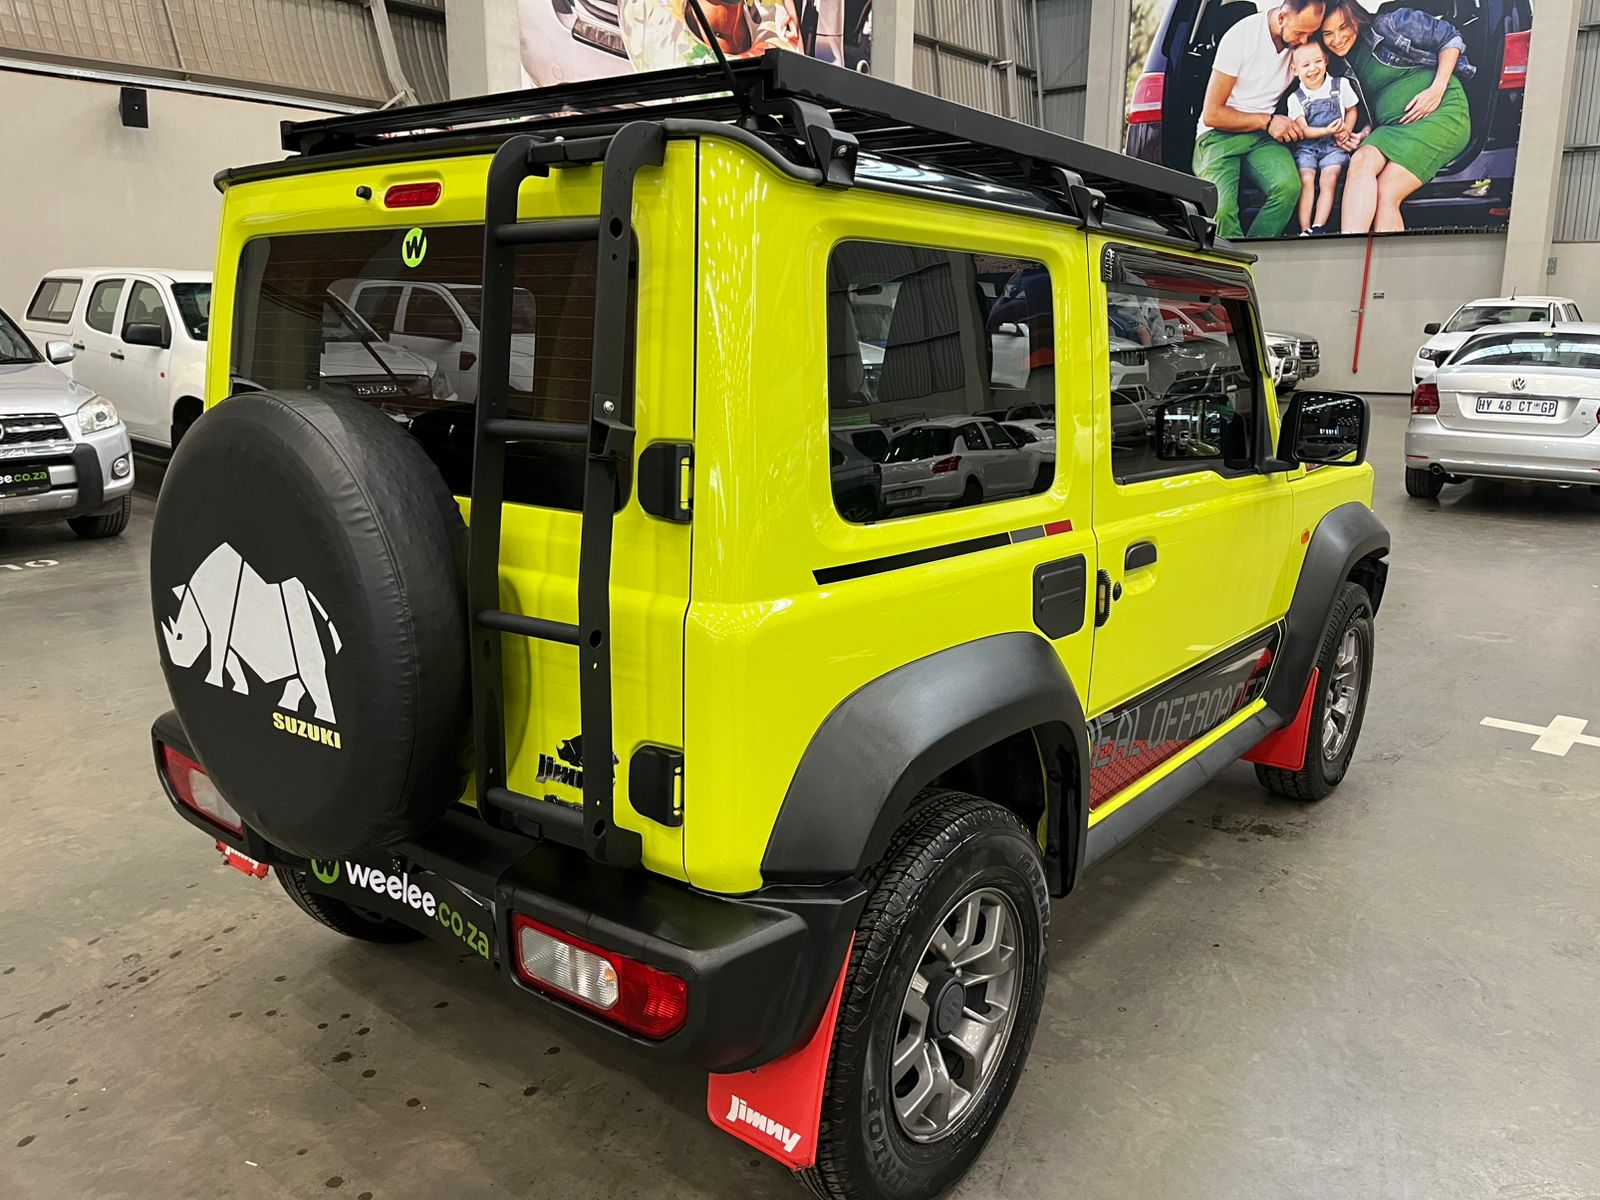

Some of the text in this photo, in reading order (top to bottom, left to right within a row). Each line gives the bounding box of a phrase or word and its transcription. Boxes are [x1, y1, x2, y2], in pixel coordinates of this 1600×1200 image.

[1478, 399, 1555, 414] HY 48 CT GP
[272, 712, 342, 749] SUZUKI
[345, 860, 490, 960] weelee.co.za
[725, 1094, 802, 1153] Jimny
